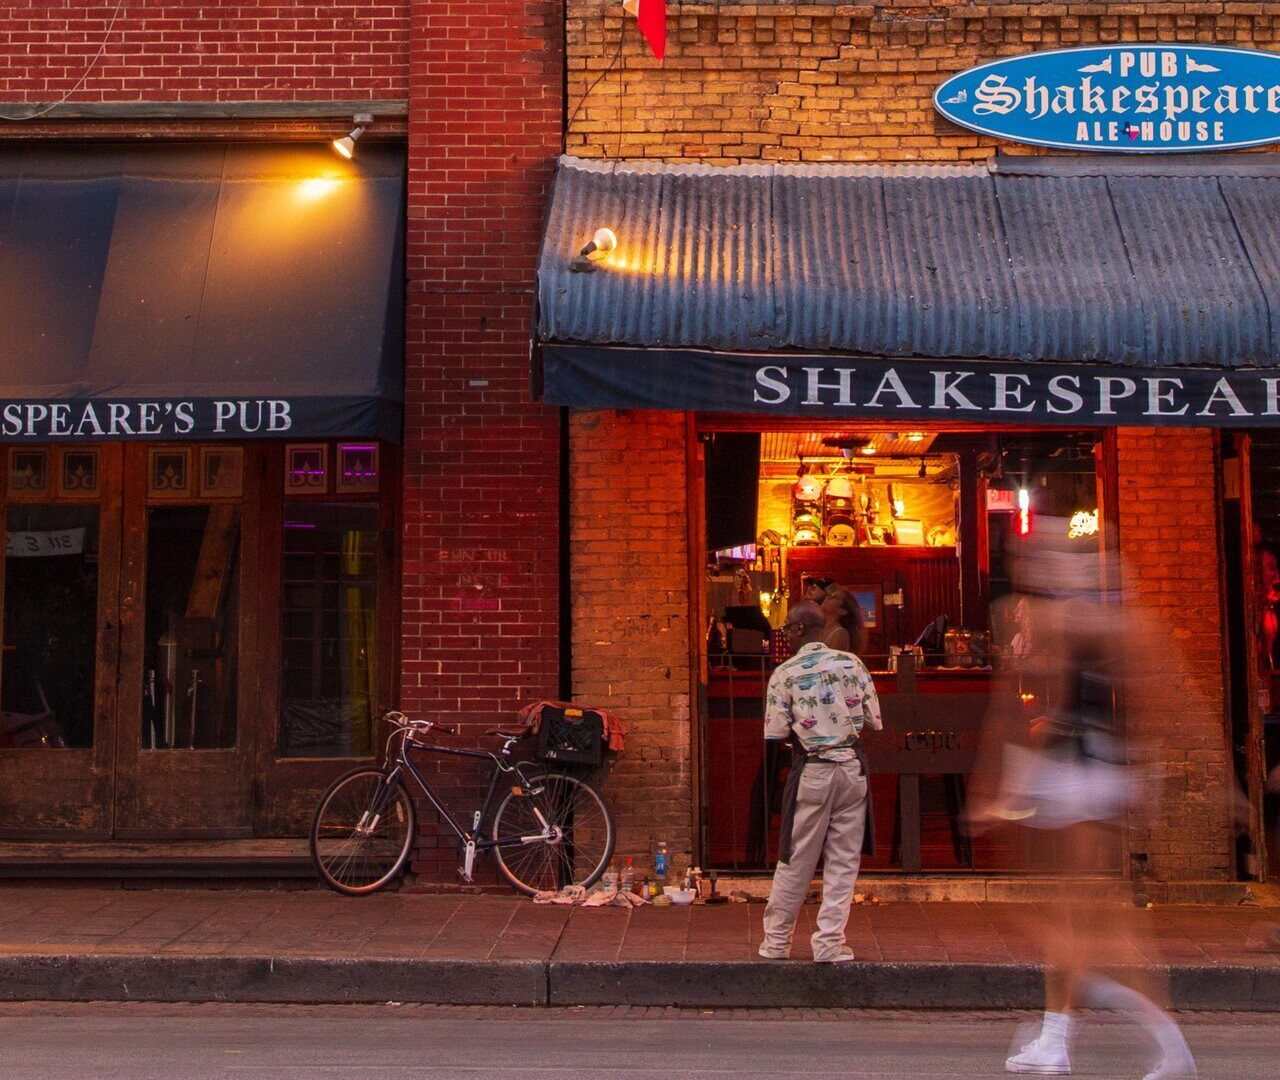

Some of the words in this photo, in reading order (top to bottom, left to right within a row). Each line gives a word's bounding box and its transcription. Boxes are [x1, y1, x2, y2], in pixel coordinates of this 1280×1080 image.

[1119, 51, 1179, 79] PUB
[1075, 120, 1119, 143] ALE
[1140, 120, 1226, 143] HOUSE
[212, 398, 294, 434] PUB
